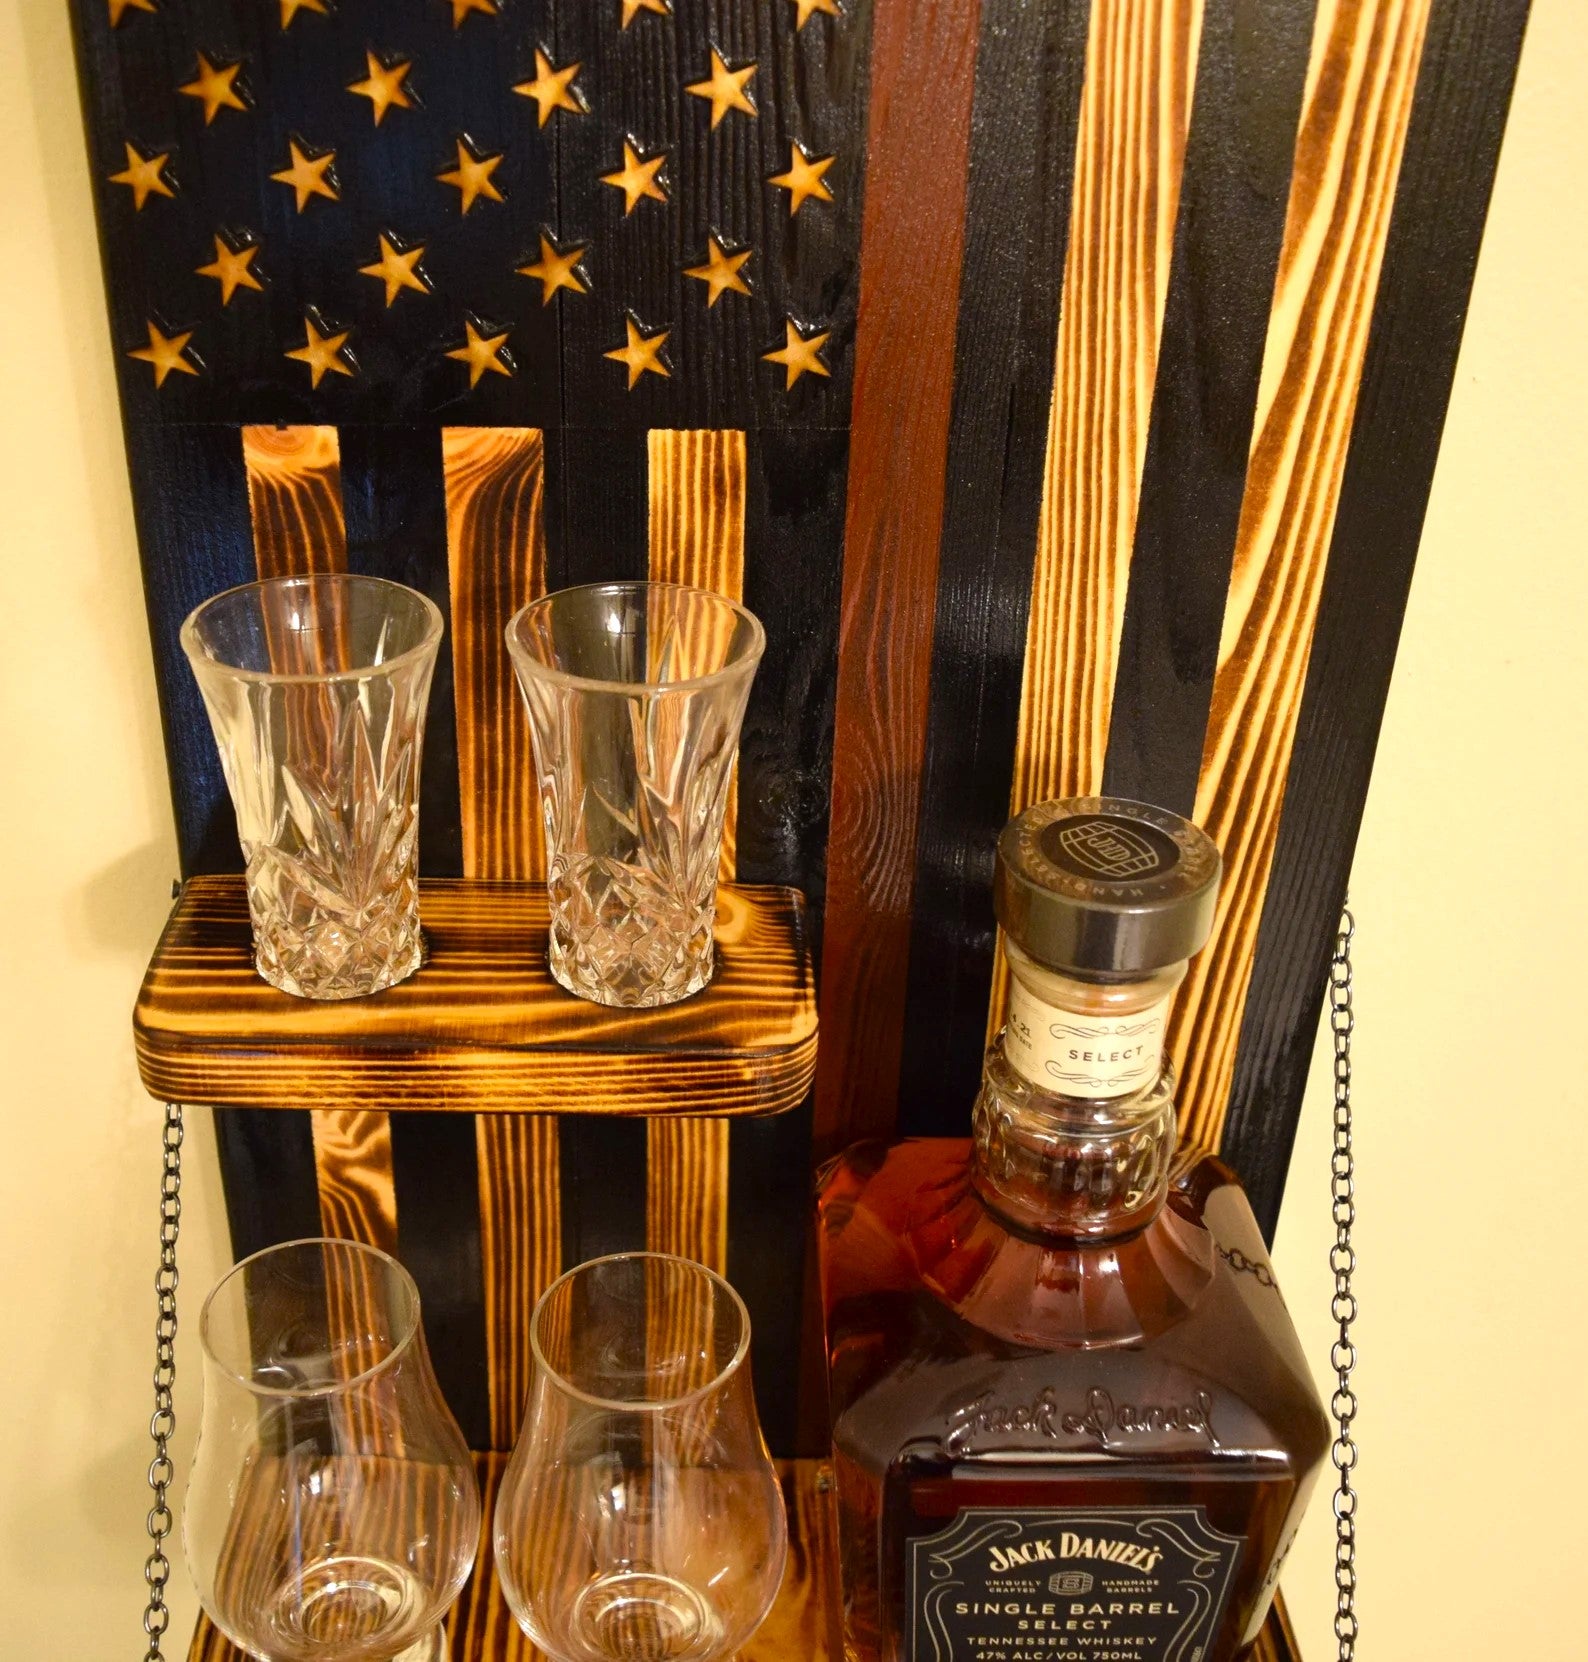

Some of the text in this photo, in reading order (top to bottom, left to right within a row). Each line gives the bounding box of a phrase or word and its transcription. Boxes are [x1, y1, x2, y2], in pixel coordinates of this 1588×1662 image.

[1068, 1045, 1144, 1062] SELECT
[988, 1531, 1164, 1575] JACK DANIEL'S
[985, 1579, 1042, 1587] UNIQUELY
[1101, 1579, 1160, 1587] HANDMADE
[1106, 1586, 1153, 1594] BARRELS
[955, 1602, 1180, 1616] SINGLE BARREL
[1017, 1619, 1112, 1631] SELECT
[967, 1636, 1157, 1646] TENNESSEE WHISKEY
[975, 1651, 1007, 1661] 47%
[1093, 1651, 1142, 1661] 750ML
